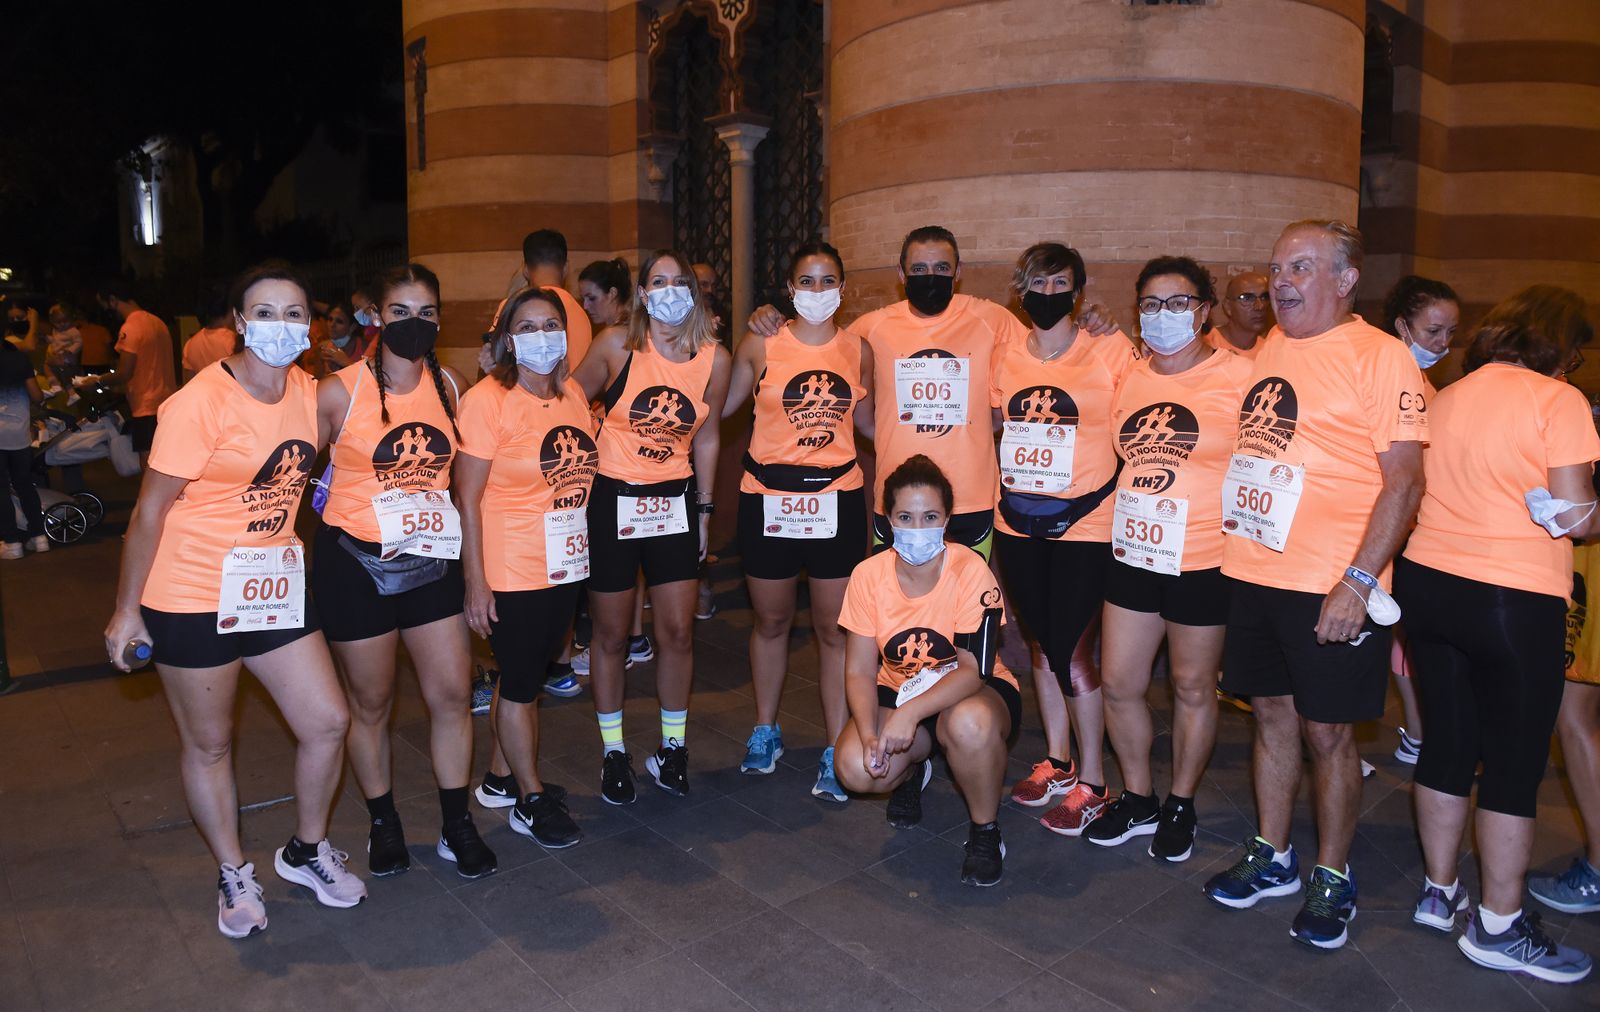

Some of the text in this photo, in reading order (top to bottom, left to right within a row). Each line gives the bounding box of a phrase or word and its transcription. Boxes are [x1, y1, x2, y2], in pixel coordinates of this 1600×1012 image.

[912, 382, 951, 401] 606
[789, 411, 844, 424] LA NOCTURNA
[1244, 430, 1288, 452] NOCTURNA
[1014, 446, 1053, 468] 649
[1126, 446, 1189, 460] LA NOCTURNA
[547, 477, 559, 487] LA
[241, 494, 256, 504] LA
[635, 496, 671, 515] 535
[781, 497, 820, 515] 540
[1236, 485, 1273, 515] 560
[402, 511, 444, 535] 558
[1125, 518, 1163, 545] 530
[242, 576, 289, 601] 600
